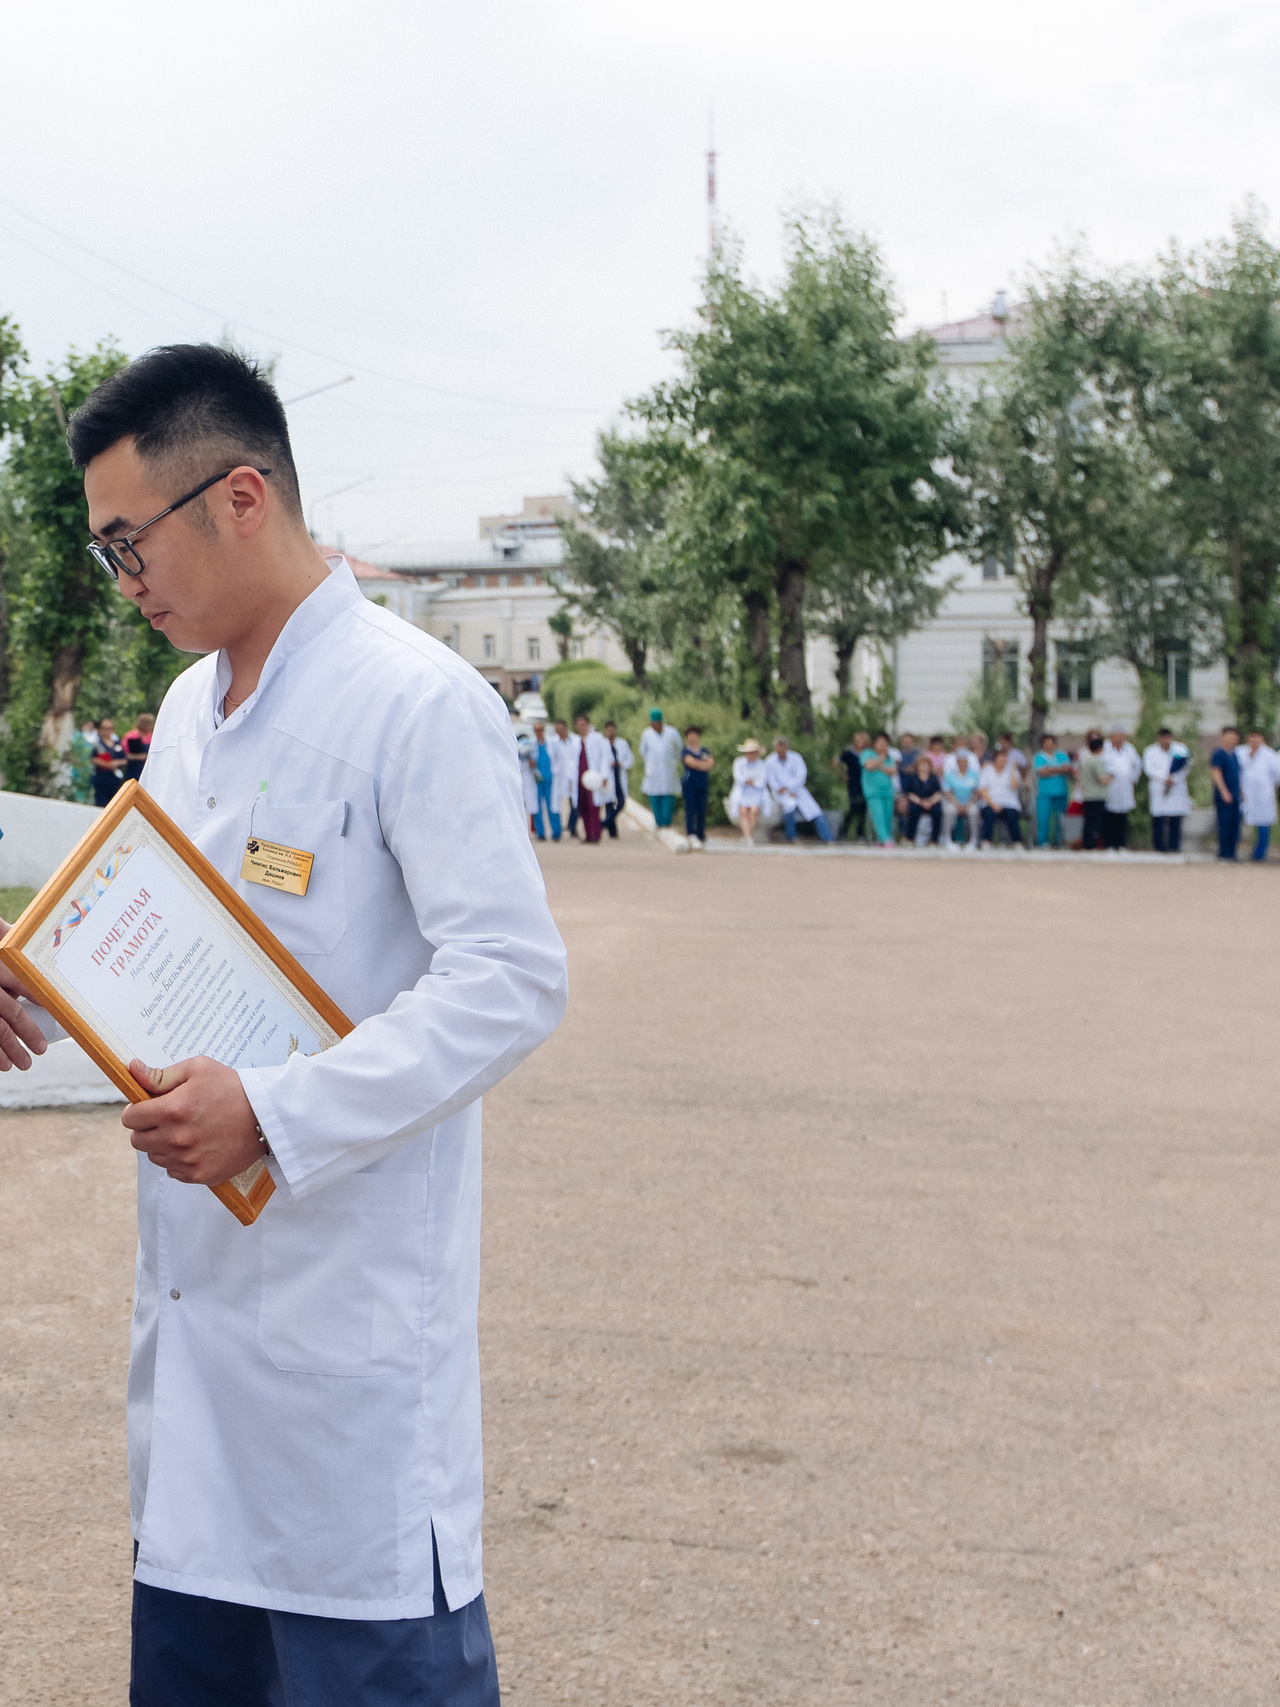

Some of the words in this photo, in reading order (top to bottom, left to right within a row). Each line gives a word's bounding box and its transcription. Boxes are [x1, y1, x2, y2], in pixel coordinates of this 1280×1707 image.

[91, 887, 151, 965] ПОЧЕТНАЯ
[110, 910, 162, 977] ГРАМОТА
[129, 927, 170, 980] Награждается
[140, 988, 164, 1019] Чингис
[161, 935, 204, 992] Бальжирович
[147, 950, 174, 986] Дашиев
